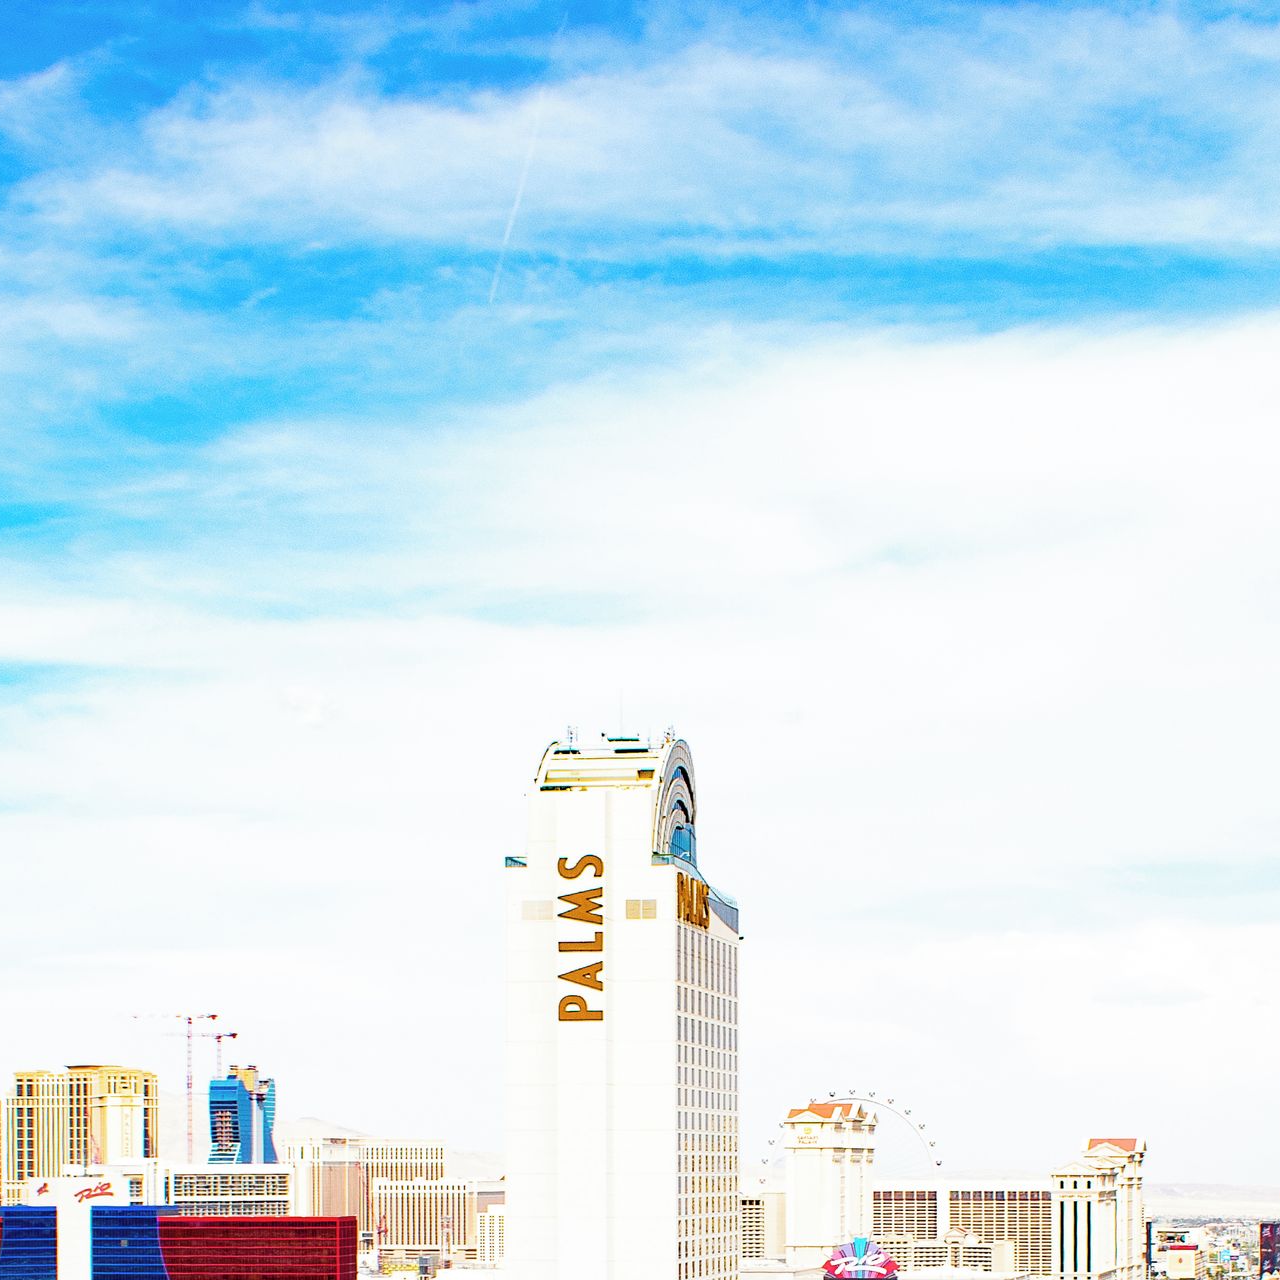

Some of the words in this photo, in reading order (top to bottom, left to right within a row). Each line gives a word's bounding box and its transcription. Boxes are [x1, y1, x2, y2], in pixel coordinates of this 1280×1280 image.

[558, 854, 604, 1021] PALMS
[74, 1181, 115, 1203] Rio
[830, 1249, 887, 1275] Rio
